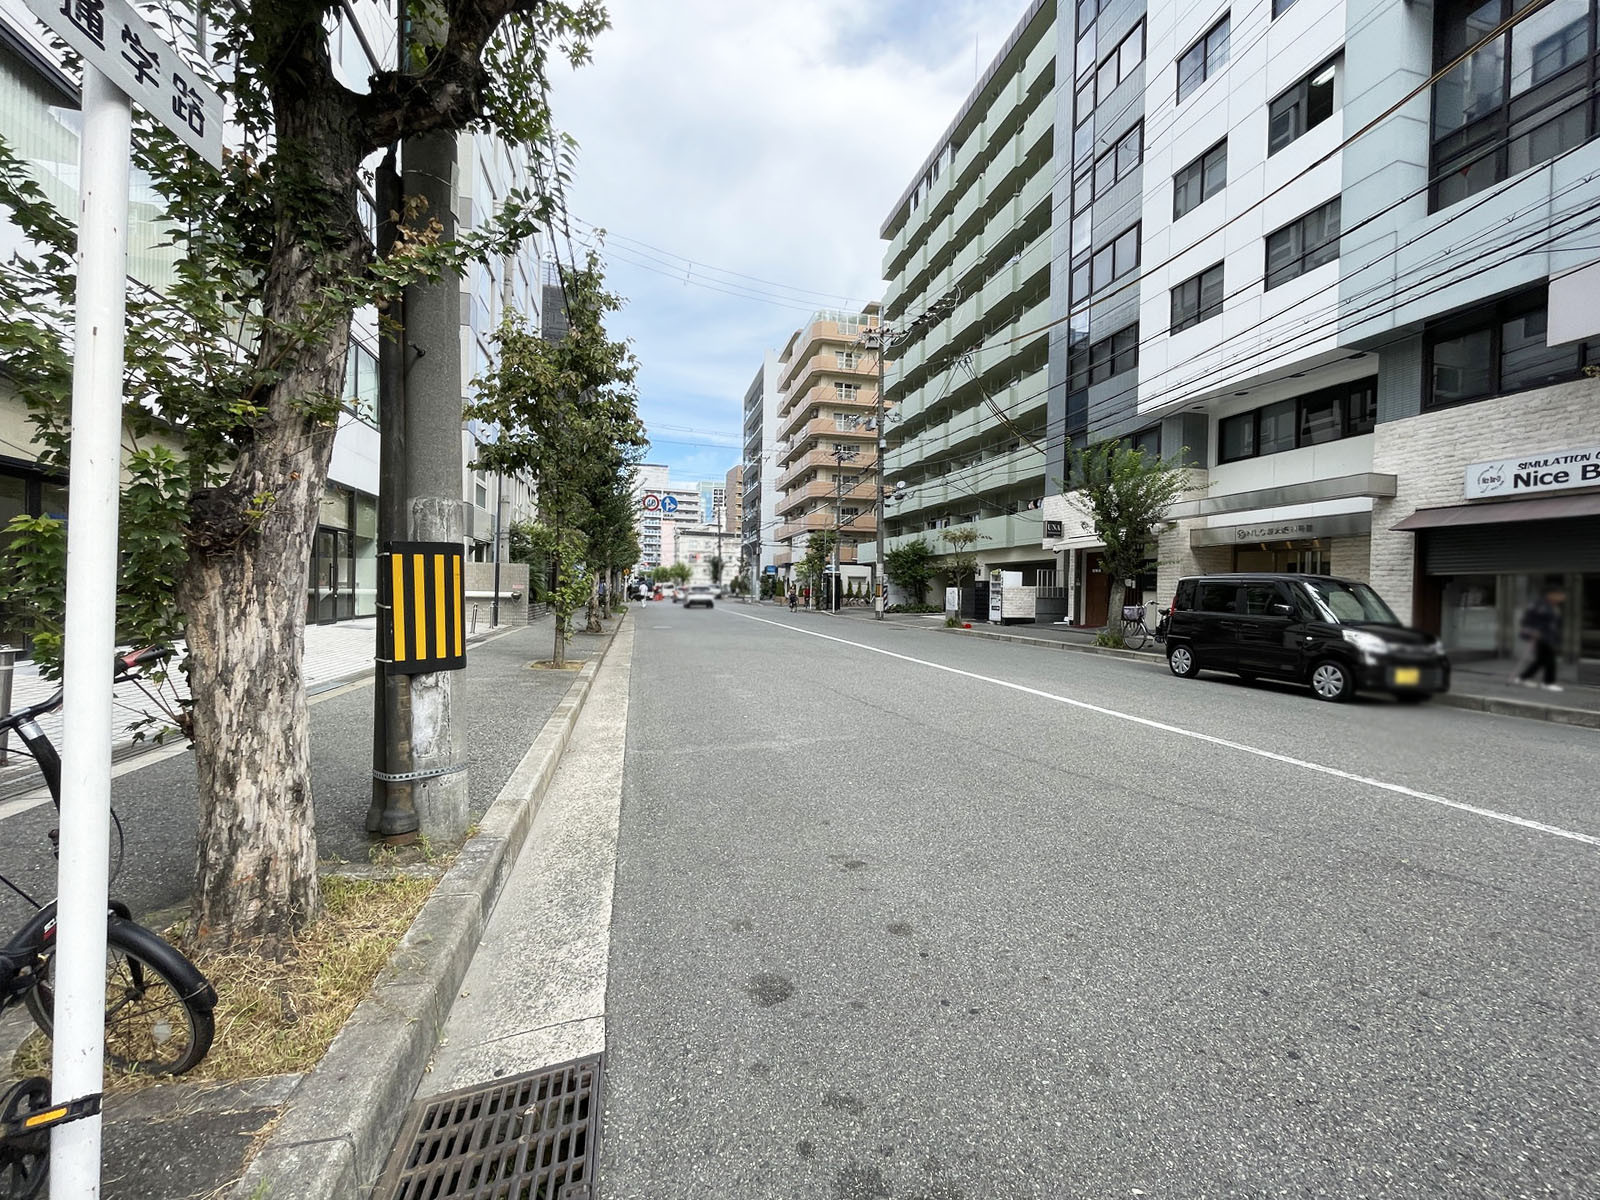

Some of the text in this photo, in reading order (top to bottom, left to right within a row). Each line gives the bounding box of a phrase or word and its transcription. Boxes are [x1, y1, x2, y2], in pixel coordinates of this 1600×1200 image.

[60, 0, 206, 138] 通学路
[1517, 453, 1591, 470] SIMULATION
[1513, 470, 1570, 488] Nice
